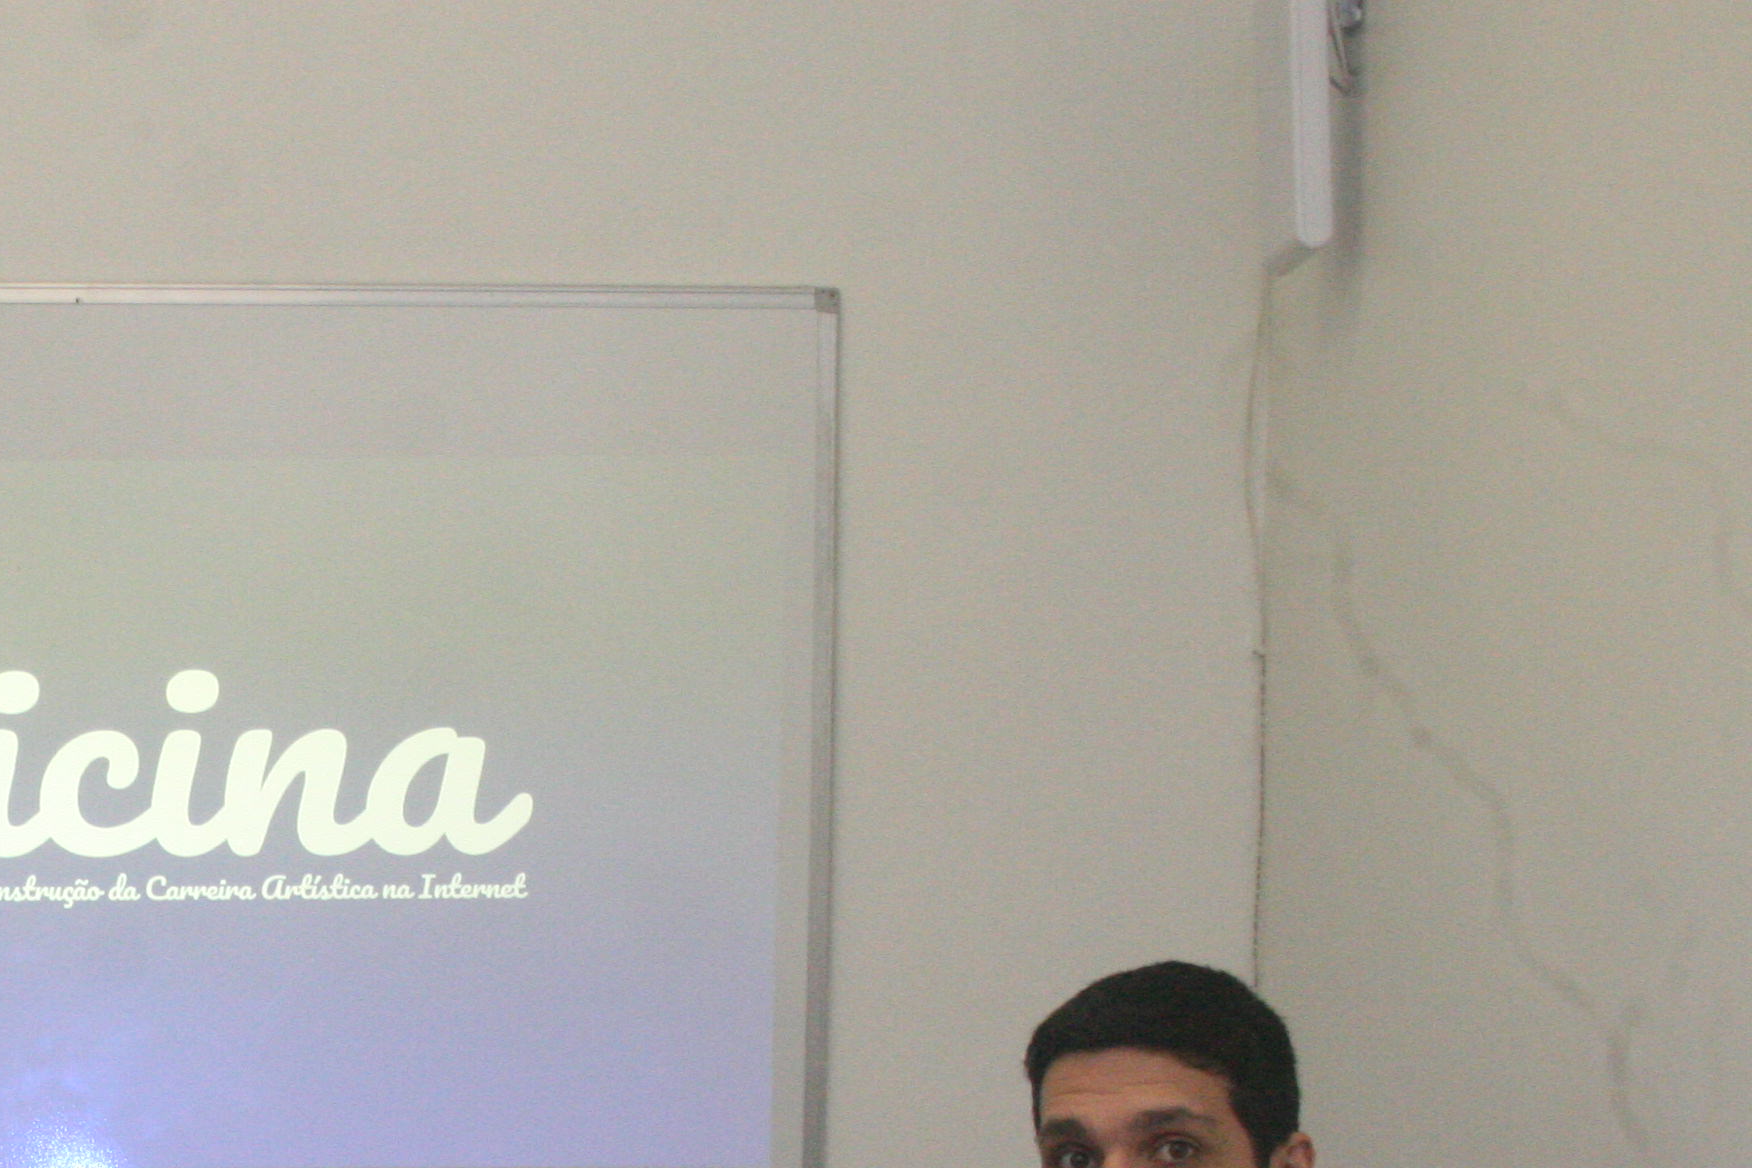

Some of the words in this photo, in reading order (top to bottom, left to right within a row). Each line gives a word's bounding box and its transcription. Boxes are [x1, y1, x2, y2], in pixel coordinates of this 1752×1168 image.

[108, 873, 142, 901] da
[145, 874, 256, 901] Carreira
[261, 873, 378, 900] Artística
[382, 883, 415, 900] na
[417, 872, 528, 899] Internet
